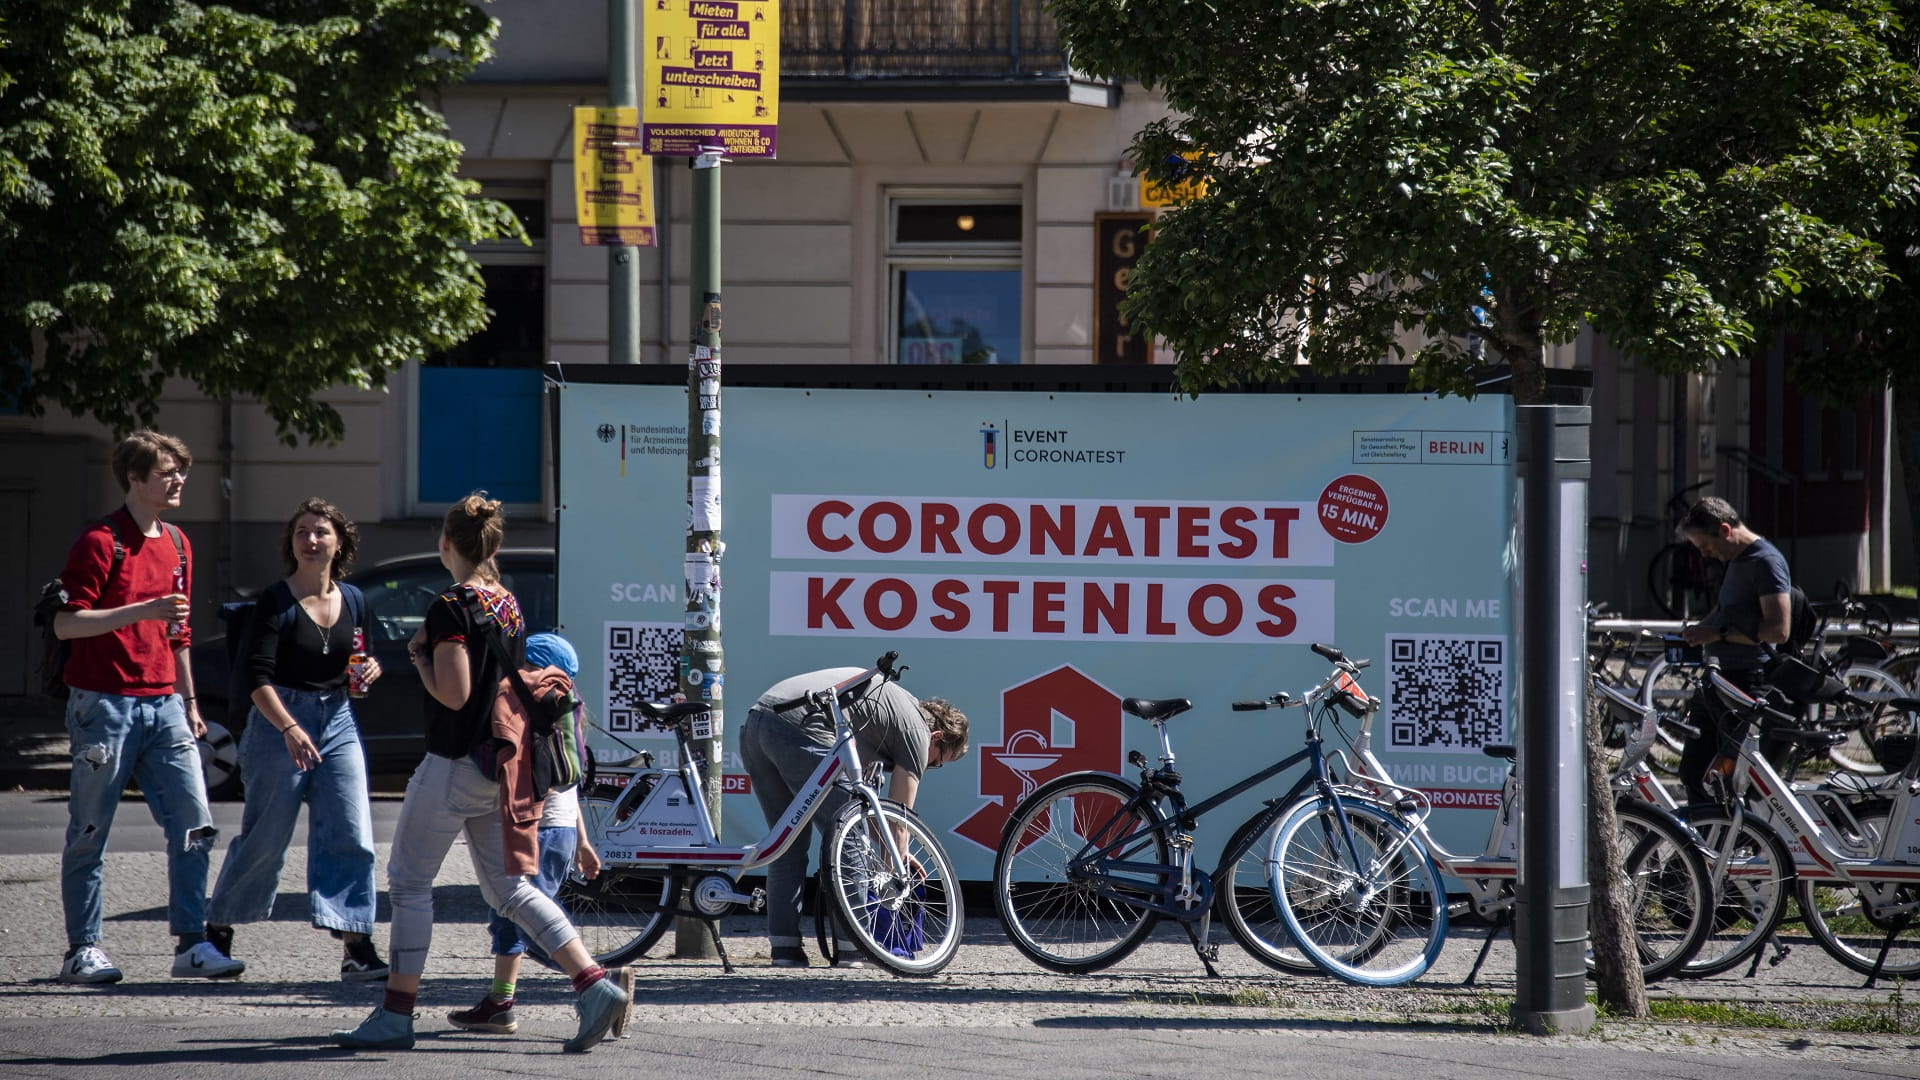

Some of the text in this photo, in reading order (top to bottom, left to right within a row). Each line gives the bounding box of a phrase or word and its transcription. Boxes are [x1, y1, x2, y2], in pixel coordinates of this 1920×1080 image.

[693, 3, 734, 18] Mieten
[701, 25, 746, 38] für alle.
[698, 54, 728, 68] Jetzt
[666, 71, 758, 89] unterschreiben.
[650, 128, 717, 137] VOLKSENTSCHEID
[724, 137, 753, 146] WOHNEN
[761, 138, 771, 146] CO
[729, 146, 766, 154] ENTEIGNEN
[631, 424, 686, 435] Bundesinstitut
[1014, 430, 1068, 443] EVENT
[631, 436, 689, 445] für Arzneimitte
[631, 446, 646, 455] und
[1429, 441, 1485, 455] BERLIN
[1014, 449, 1126, 464] CORONATEST
[1339, 485, 1377, 501] ERGEBNIS
[1328, 491, 1383, 511] VERFÜGBAR IN
[1322, 503, 1379, 531] 15 MIN.
[806, 500, 1301, 559] CORONATEST
[610, 583, 676, 602] SCAN
[807, 577, 1298, 638] KOSTENLOS
[1389, 598, 1501, 618] SCAN ME
[692, 713, 710, 723] HD
[1384, 764, 1503, 784] MIN BUCH
[790, 809, 804, 825] Call
[804, 789, 820, 806] Bike
[1770, 797, 1785, 812] Call
[1785, 816, 1800, 834] Bike
[639, 827, 694, 836] & losradeln.
[604, 850, 633, 859] 20832
